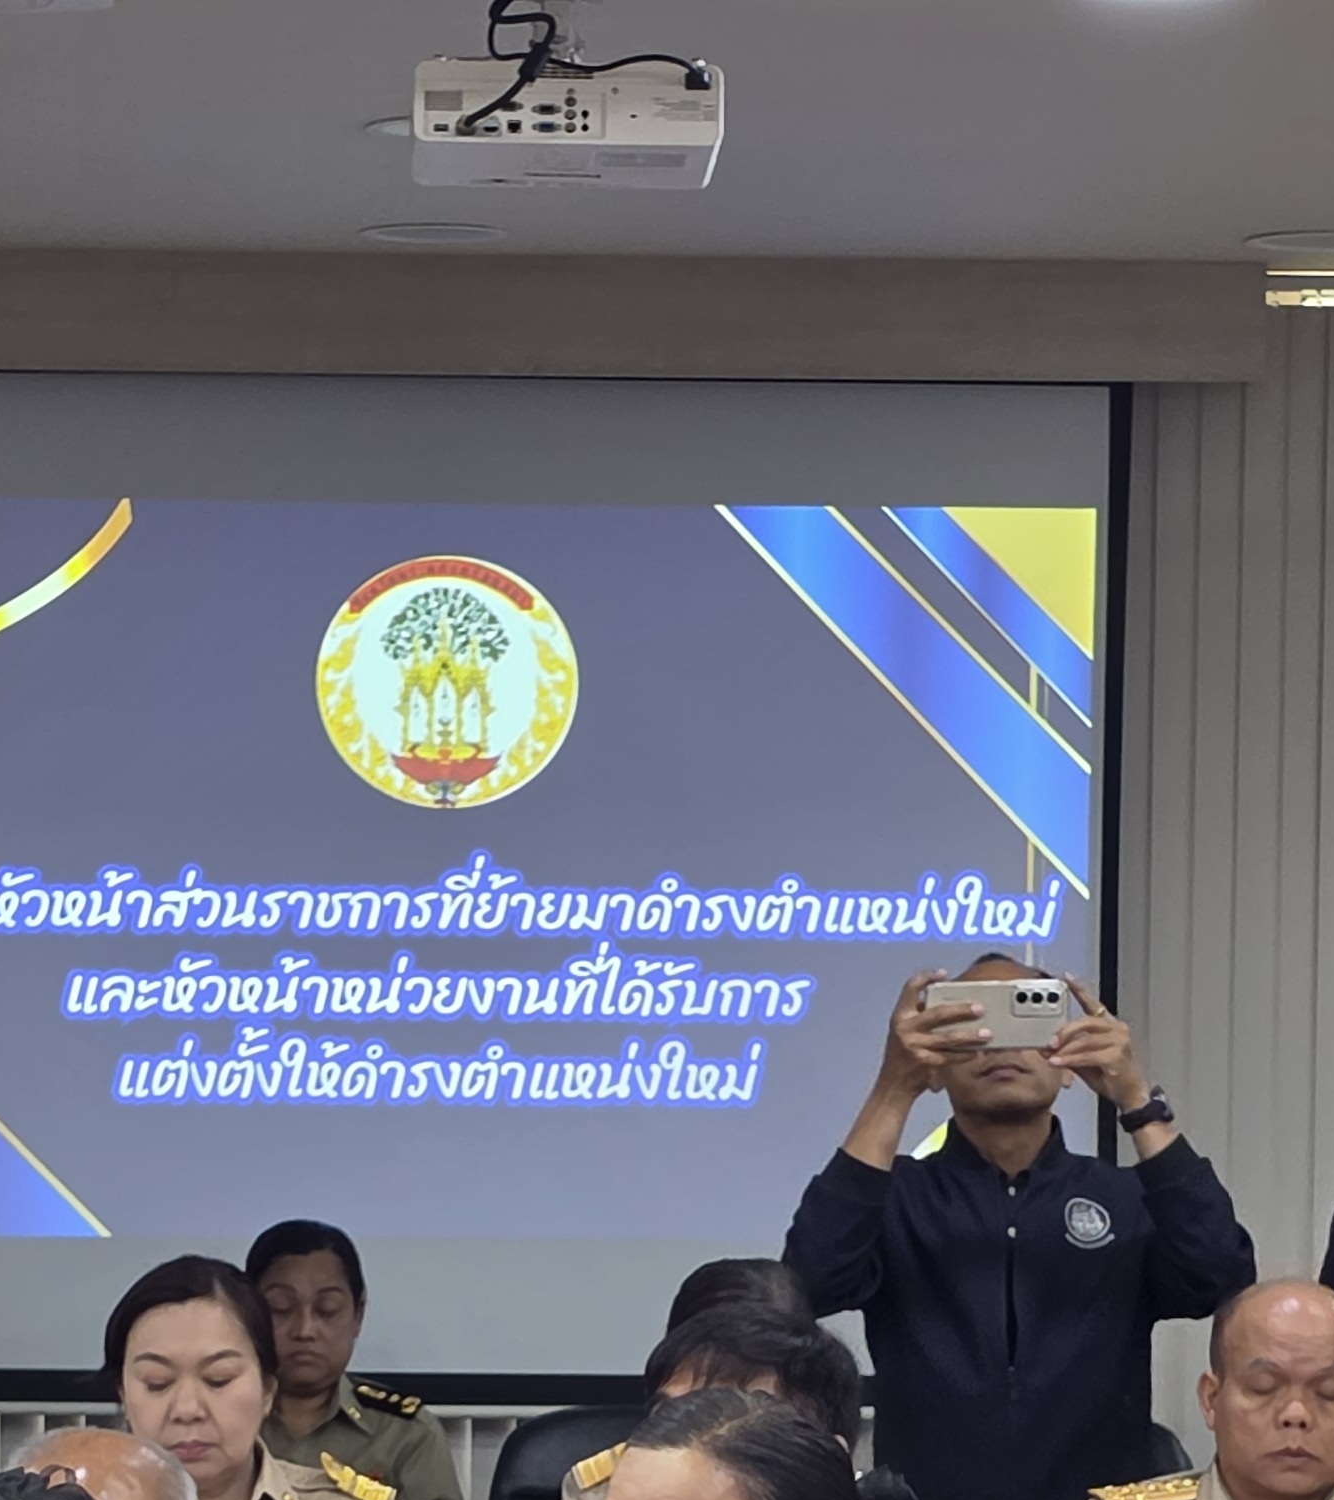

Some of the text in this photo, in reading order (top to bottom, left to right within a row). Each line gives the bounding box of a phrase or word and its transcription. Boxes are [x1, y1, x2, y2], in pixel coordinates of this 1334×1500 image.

[66, 942, 812, 1018] และหัวหน้าหน่วยงานที่ได้รับการ
[117, 1026, 762, 1100] แต่งตั้งให้ดำรงตำแหน่งใหม่
